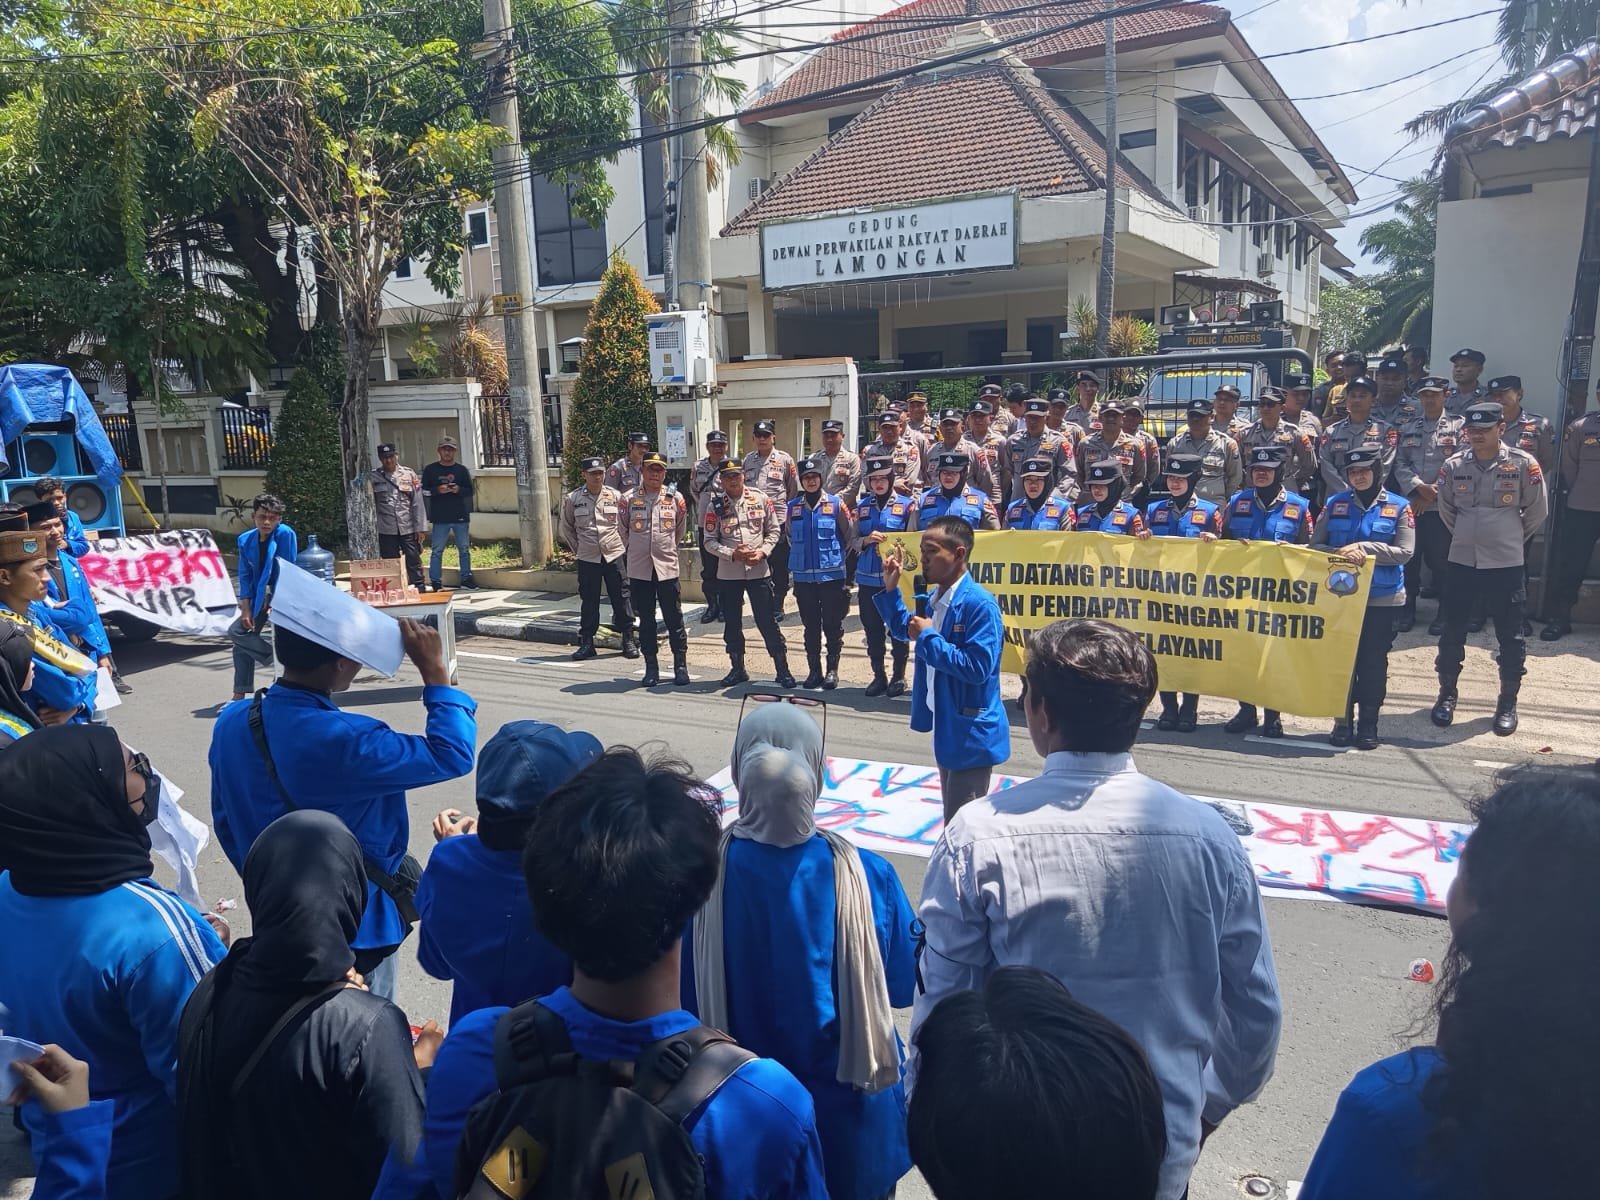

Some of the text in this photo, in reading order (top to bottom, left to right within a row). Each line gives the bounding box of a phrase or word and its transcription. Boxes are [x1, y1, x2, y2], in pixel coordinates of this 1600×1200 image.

[772, 222, 1008, 261] DEWAN PERWAKILAN RAKYAT DAERAH
[848, 214, 919, 234] GEDUNG
[815, 244, 967, 277] LAMONGAN
[1187, 333, 1262, 346] PUBLIC ADDRESS
[1010, 562, 1095, 587] DATANG
[1099, 565, 1198, 597] PEJUANG
[1202, 574, 1319, 605] ASPIRASI
[994, 593, 1325, 640] AN PENDAPAT DENGAN TERTIB
